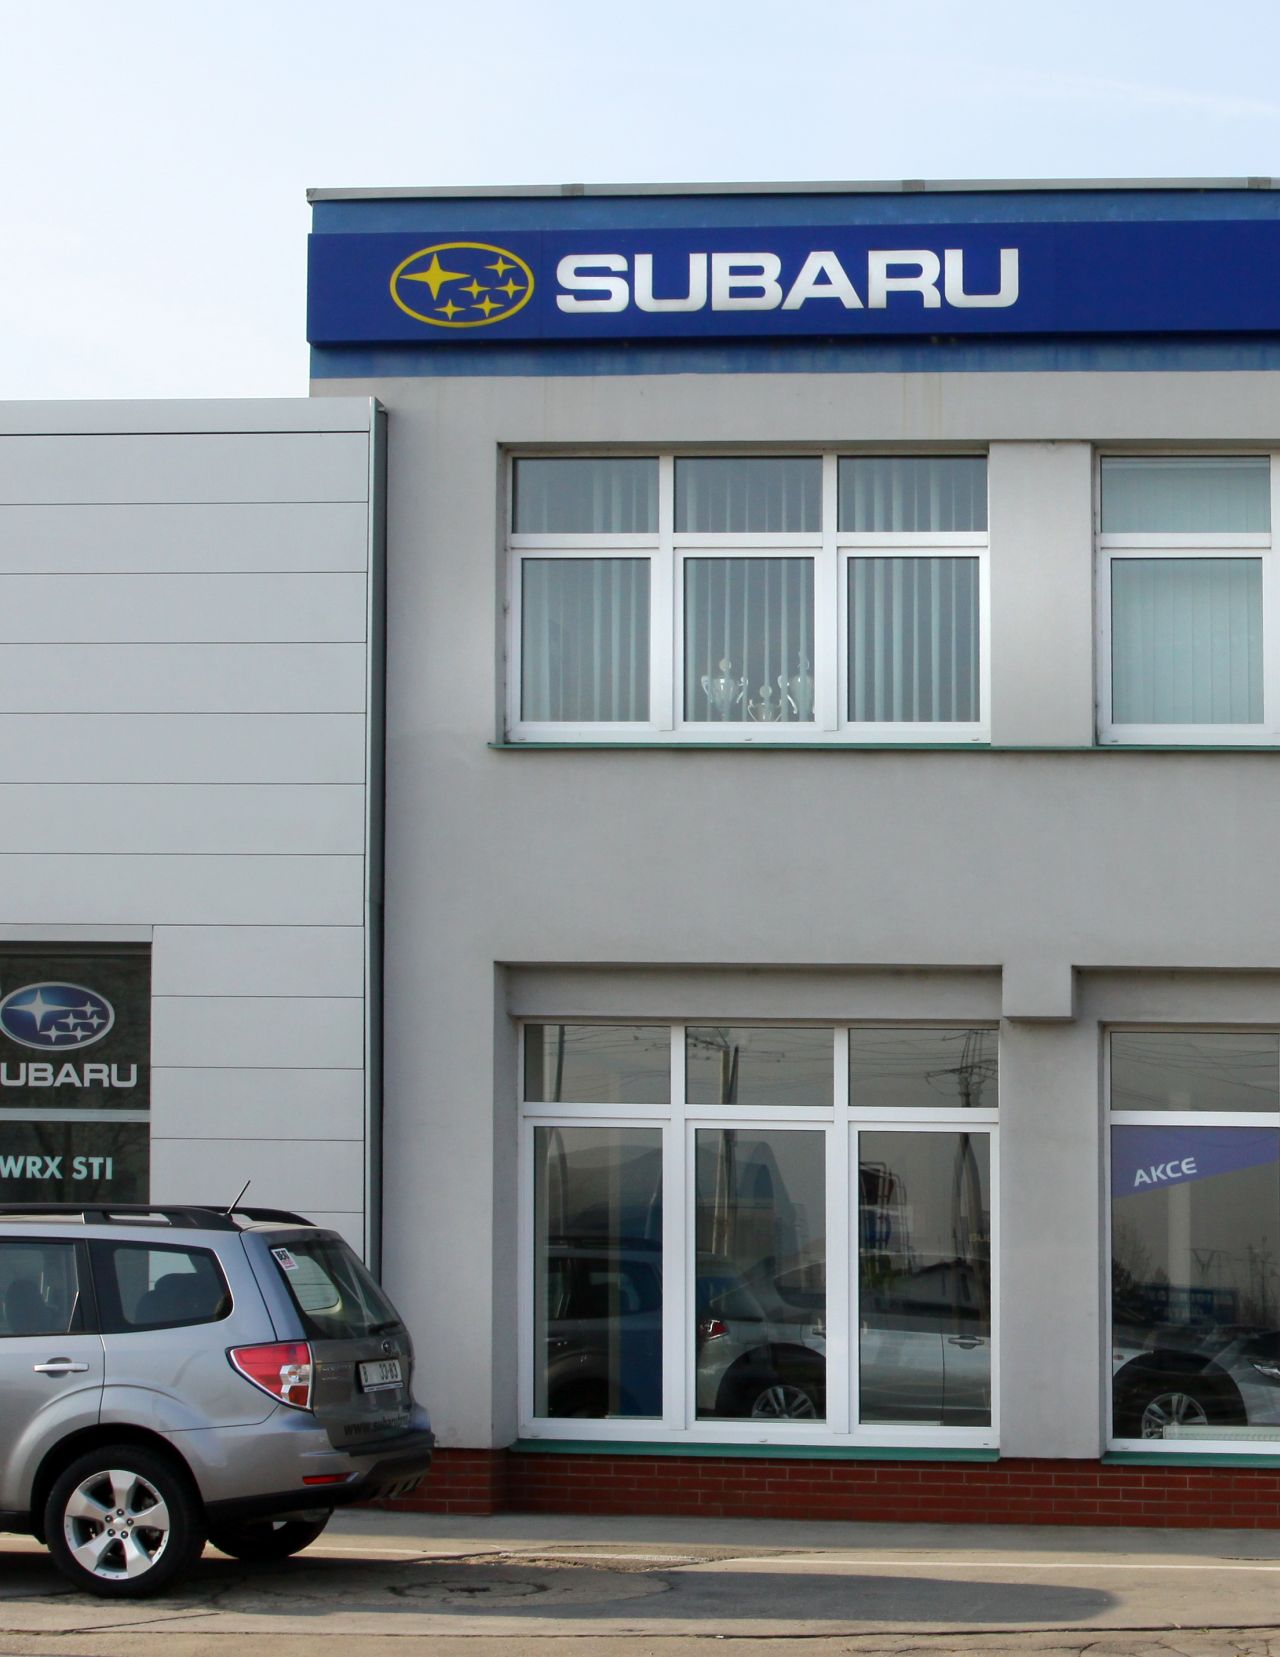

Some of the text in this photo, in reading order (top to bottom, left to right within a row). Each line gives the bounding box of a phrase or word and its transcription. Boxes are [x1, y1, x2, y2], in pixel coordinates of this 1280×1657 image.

[556, 248, 1019, 313] SUBARU
[0, 1062, 138, 1088] UBARU
[0, 1155, 113, 1180] WRX STI
[1133, 1157, 1198, 1187] AKCE
